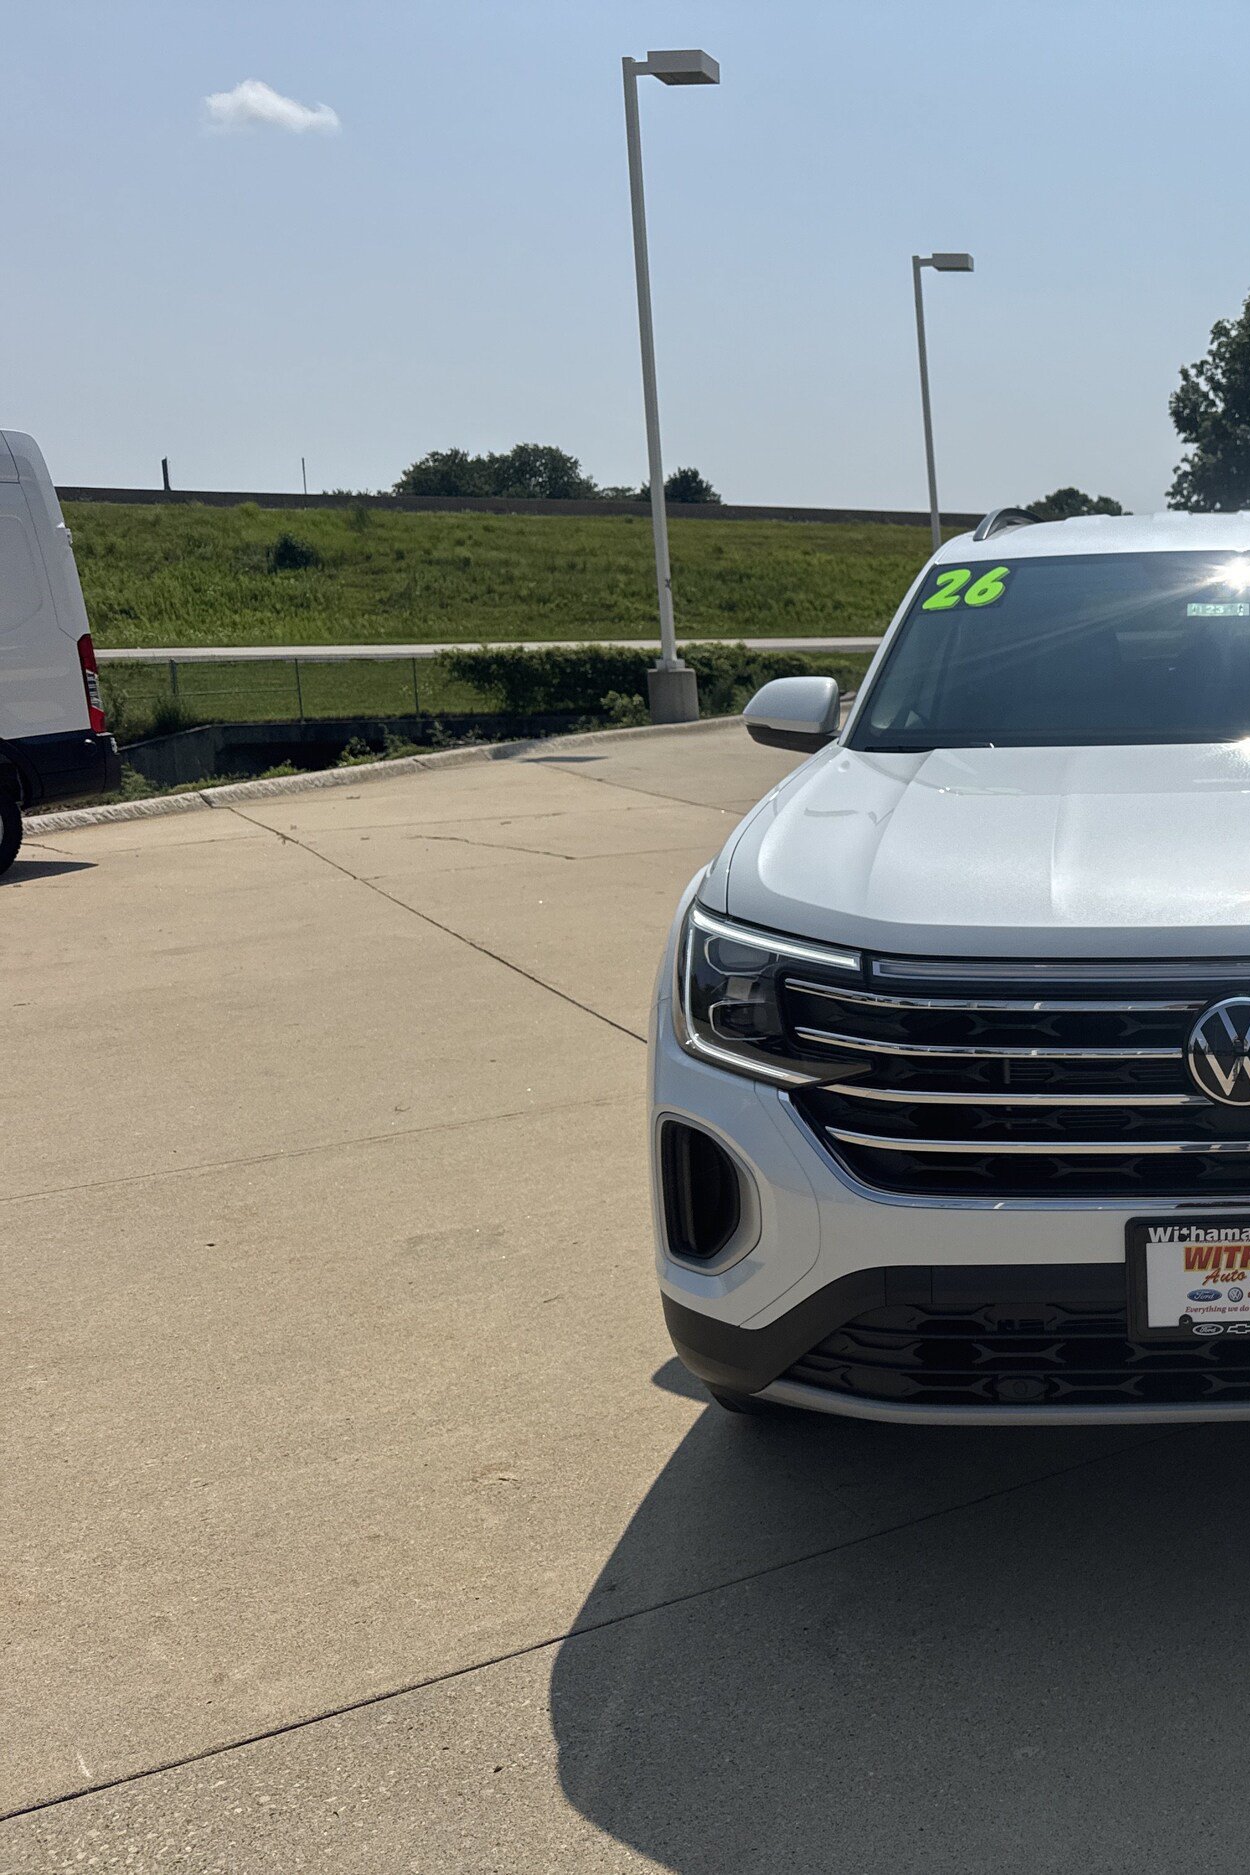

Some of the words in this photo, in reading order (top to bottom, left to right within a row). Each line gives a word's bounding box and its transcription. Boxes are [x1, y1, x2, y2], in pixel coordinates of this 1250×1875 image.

[922, 566, 1010, 611] 26
[1202, 1267, 1247, 1286] Auto
[1185, 1304, 1226, 1314] Everything
[1239, 1304, 1249, 1312] do
